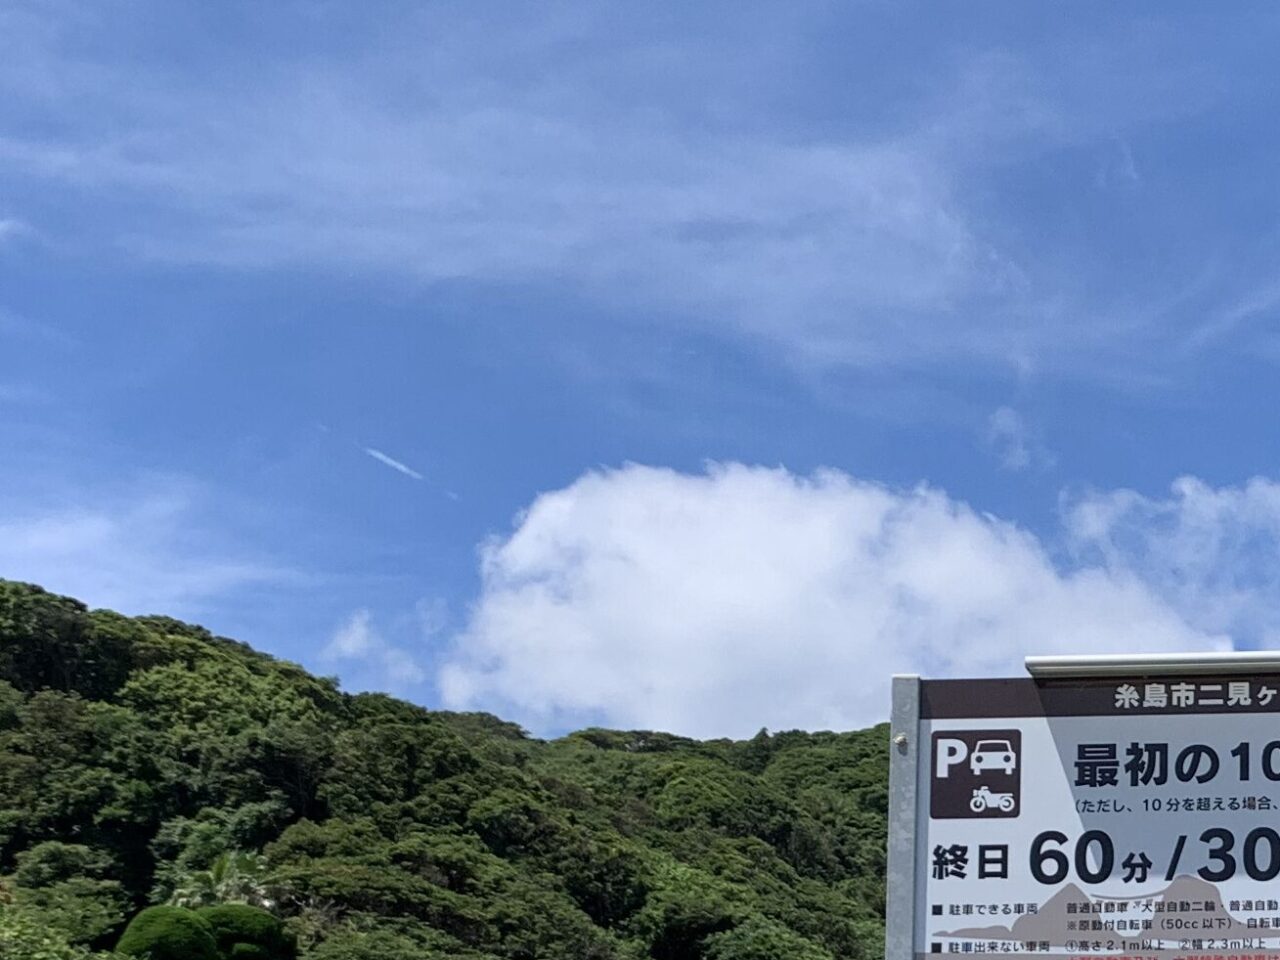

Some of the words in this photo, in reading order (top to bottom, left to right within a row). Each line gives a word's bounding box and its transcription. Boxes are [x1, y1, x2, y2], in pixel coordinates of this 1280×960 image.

[935, 738, 969, 778] P
[948, 902, 1039, 915] 駐車できる車両
[948, 940, 1050, 954] 駐車出来ない車両
